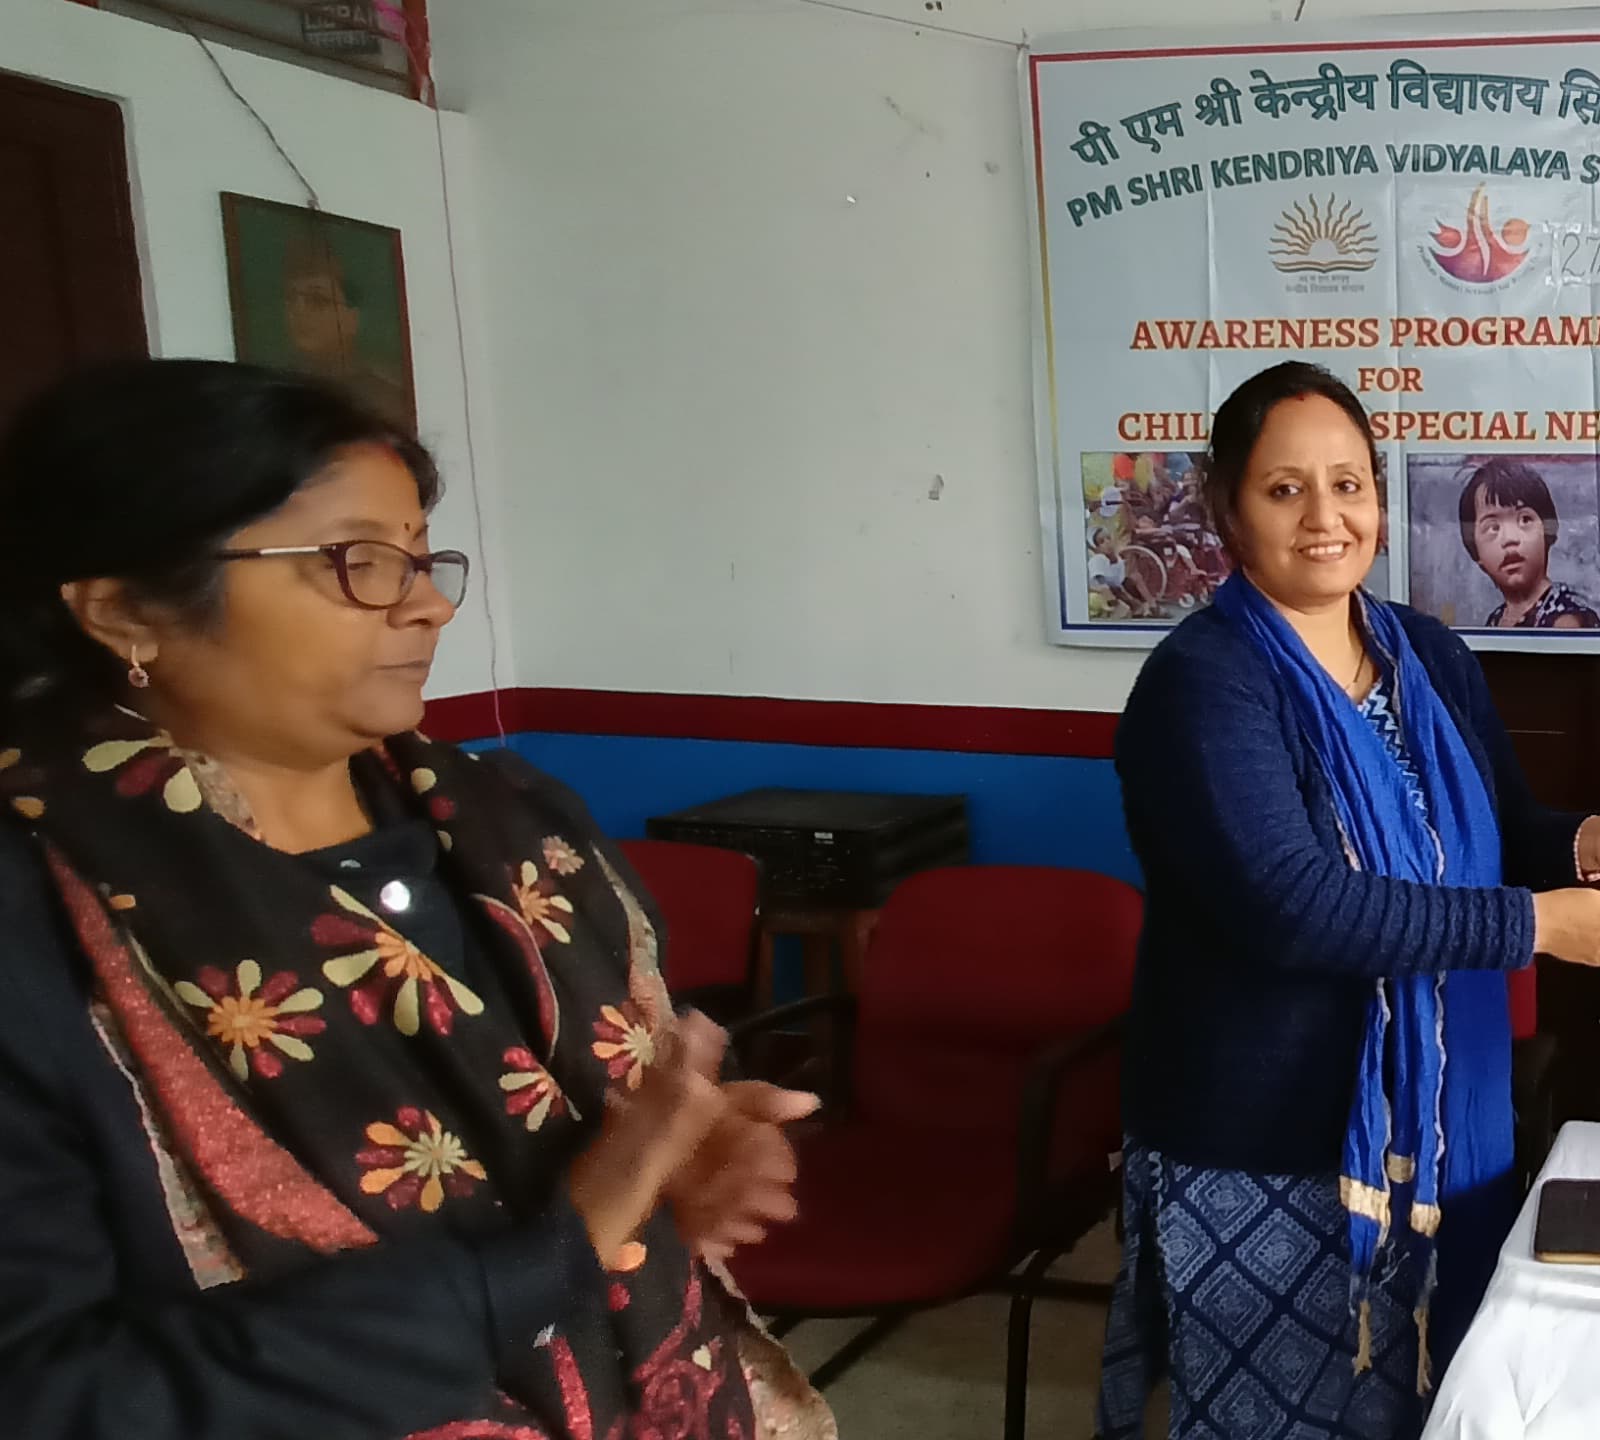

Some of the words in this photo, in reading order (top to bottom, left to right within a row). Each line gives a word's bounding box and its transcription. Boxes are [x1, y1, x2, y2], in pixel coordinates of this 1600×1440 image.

[1070, 120, 1120, 166] पी
[1120, 102, 1184, 154] एम
[1195, 78, 1242, 127] श्री
[1250, 62, 1378, 121] केन्द्रीय
[1387, 59, 1549, 115] विद्यालय
[1066, 185, 1123, 227] PM
[1129, 164, 1204, 206] SHRI
[1211, 145, 1379, 189] KENDRIYA
[1385, 143, 1571, 180] VIDYALAYA
[1130, 318, 1379, 350] AWARENESS
[1358, 367, 1423, 393] FOR
[1118, 412, 1216, 441] CHIL
[1370, 410, 1536, 441] SPECIAL
